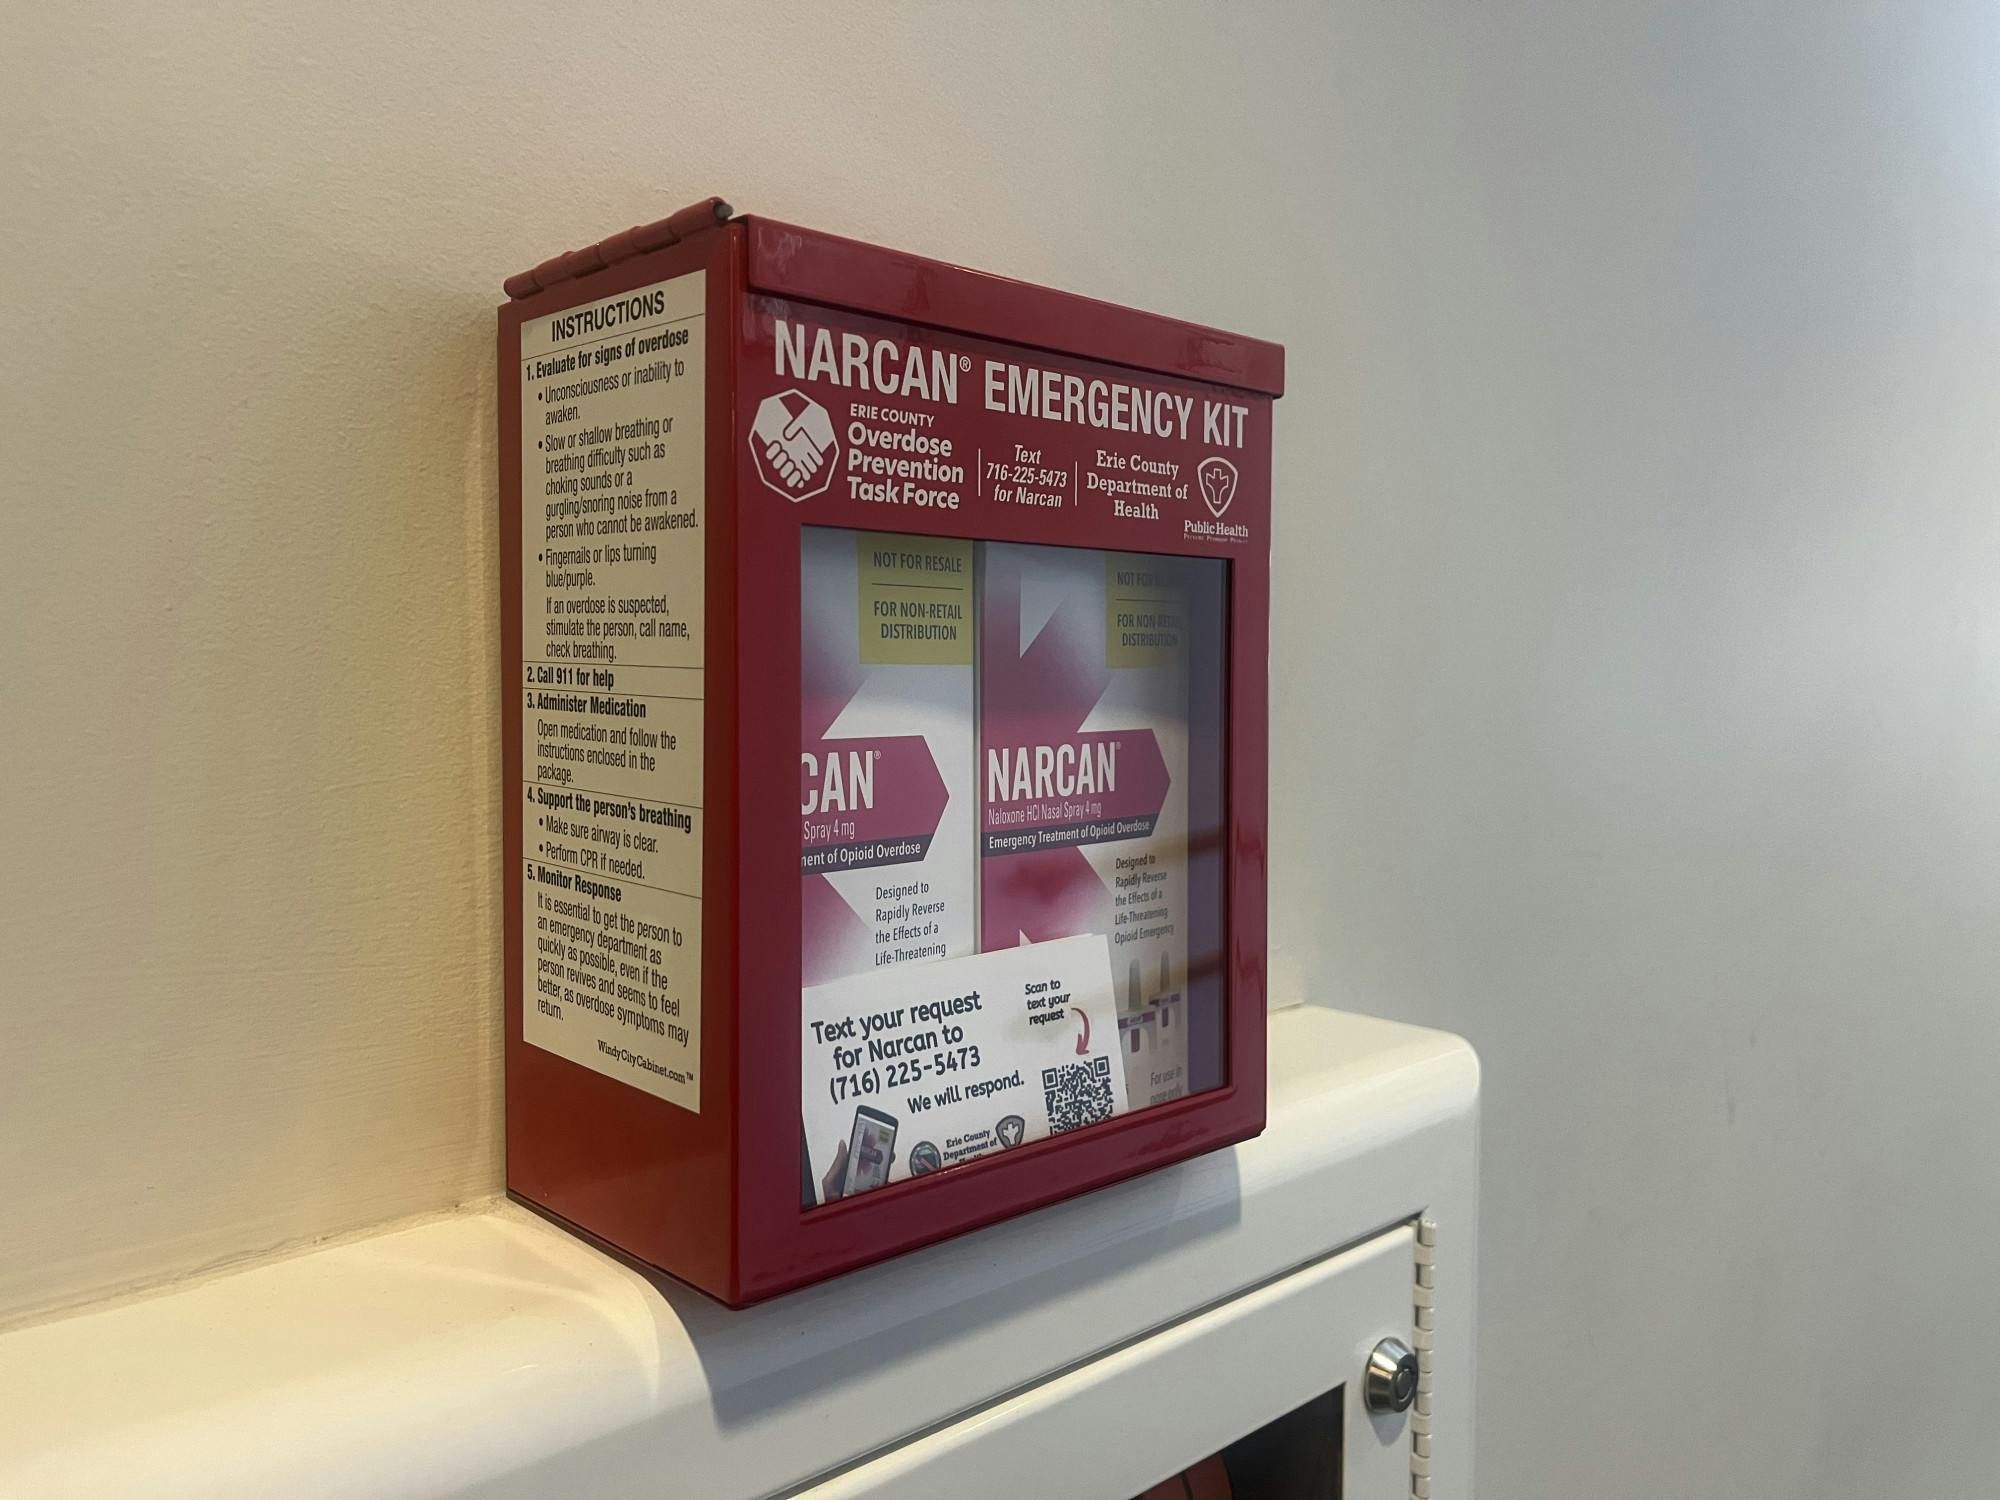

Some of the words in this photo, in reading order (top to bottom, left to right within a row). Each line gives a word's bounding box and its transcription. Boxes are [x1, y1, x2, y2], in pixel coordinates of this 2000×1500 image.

[552, 290, 665, 342] INSTRUCTIONS
[526, 366, 534, 381] 1.
[537, 357, 575, 379] Evaluate
[578, 350, 592, 368] for
[595, 345, 622, 366] signs
[625, 338, 635, 356] of
[639, 329, 688, 354] overdose
[545, 375, 619, 403] Unconsciousness
[622, 372, 630, 386] or
[634, 361, 671, 384] inability
[675, 358, 684, 376] to
[546, 406, 580, 425] awaken.
[851, 403, 878, 419] ERIE
[881, 408, 934, 427] COUNTY
[985, 360, 1194, 440] EMERGENCY
[1203, 400, 1248, 448] KIT
[848, 421, 952, 457] Overdose
[546, 453, 584, 473] breathing
[588, 448, 625, 468] difficulty
[628, 445, 650, 462] such
[654, 443, 665, 458] as
[848, 448, 963, 483] Prevention
[1014, 444, 1041, 464] Text
[1096, 450, 1126, 469] Erie
[1130, 454, 1179, 480] County
[986, 462, 1067, 488] 716-225-5473
[1086, 472, 1171, 499] Department
[1175, 484, 1188, 500] of
[546, 494, 614, 520] gurgling/snoring
[618, 492, 642, 510] noise
[645, 489, 667, 507] from
[671, 490, 677, 505] a
[847, 476, 898, 504] Task
[903, 483, 959, 509] Force
[993, 484, 1013, 502] for
[1016, 487, 1062, 508] Narcan
[1114, 500, 1159, 520] Health
[546, 524, 573, 542] person
[577, 520, 594, 537] who
[597, 519, 627, 535] cannot
[630, 515, 641, 532] be
[645, 509, 698, 530] awakened.
[546, 547, 590, 569] Fingernails
[593, 549, 600, 562] or
[605, 544, 620, 566] lips
[623, 542, 656, 564] turning
[873, 552, 897, 568] NOT
[901, 553, 922, 571] FOR
[925, 555, 962, 573] RESALE
[546, 569, 595, 590] blue/purple.
[874, 601, 897, 616] FOR
[900, 603, 963, 619] NON-RETAIL
[546, 619, 584, 636] stimulate
[587, 619, 600, 636] the
[603, 620, 637, 639] person,
[640, 619, 656, 637] call
[659, 620, 689, 640] name,
[881, 624, 957, 640] DISTRIBUTION
[546, 641, 570, 657] check
[573, 641, 616, 663] breathing.
[527, 667, 534, 682] 2.
[537, 667, 553, 684] Call
[557, 668, 573, 685] 911
[577, 668, 590, 685] for
[593, 669, 614, 690] help
[527, 693, 535, 708] 3.
[537, 693, 587, 713] Administer
[590, 696, 646, 718] Medication
[538, 719, 558, 737] Open
[561, 722, 607, 742] medication
[610, 727, 626, 744] and
[630, 728, 658, 748] follow
[661, 731, 676, 750] the
[537, 741, 584, 762] instructions
[587, 750, 625, 767] enclosed
[629, 751, 637, 769] in
[640, 752, 655, 771] the
[538, 764, 574, 784] package.
[527, 787, 535, 802] 4.
[538, 787, 573, 810] Support
[576, 793, 590, 812] the
[594, 800, 635, 820] person's
[639, 805, 691, 834] breathing
[546, 816, 568, 835] Make
[571, 823, 589, 839] sure
[592, 825, 620, 848] airway
[623, 831, 631, 847] is
[634, 832, 658, 853] clear.
[989, 834, 1037, 849] Emergency
[1038, 828, 1079, 844] Treatment
[1081, 826, 1089, 838] of
[1090, 823, 1115, 839] Opioid
[546, 842, 577, 863] Perform
[581, 849, 598, 867] CPR
[600, 852, 606, 869] if
[609, 857, 644, 879] needed.
[828, 850, 838, 863] of
[840, 843, 874, 865] Opioid
[877, 842, 921, 858] Overdose
[527, 864, 535, 880] 5.
[538, 866, 572, 889] Monitor
[575, 875, 621, 902] Response
[876, 882, 918, 901] Designed
[921, 882, 929, 894] to
[876, 904, 910, 924] Rapidly
[912, 901, 945, 915] Reverse
[538, 915, 547, 929] an
[550, 919, 594, 947] emergency
[598, 931, 647, 961] department
[650, 949, 661, 965] as
[875, 930, 890, 944] the
[894, 923, 921, 940] Effects
[923, 922, 931, 935] of
[934, 924, 938, 934] a
[875, 942, 946, 966] Life-Threatening
[1025, 983, 1047, 995] Scan
[1050, 980, 1061, 990] to
[538, 998, 564, 1021] return.
[538, 976, 562, 1002] better,
[564, 988, 573, 1003] as
[576, 989, 615, 1017] overdose
[618, 1006, 664, 1035] symptoms
[668, 1023, 689, 1047] may
[1027, 997, 1046, 1010] text
[1048, 992, 1070, 1008] your
[811, 1016, 856, 1044] Text
[859, 1009, 904, 1040] your
[910, 991, 982, 1024] request
[1029, 1009, 1064, 1026] request
[833, 1047, 862, 1070] for
[868, 1031, 937, 1062] Narcan
[942, 1024, 963, 1044] to
[830, 1068, 880, 1104] (716)
[886, 1045, 981, 1088] 225-5473
[907, 1095, 931, 1114] We
[935, 1085, 962, 1107] will
[964, 1070, 1024, 1098] respond.
